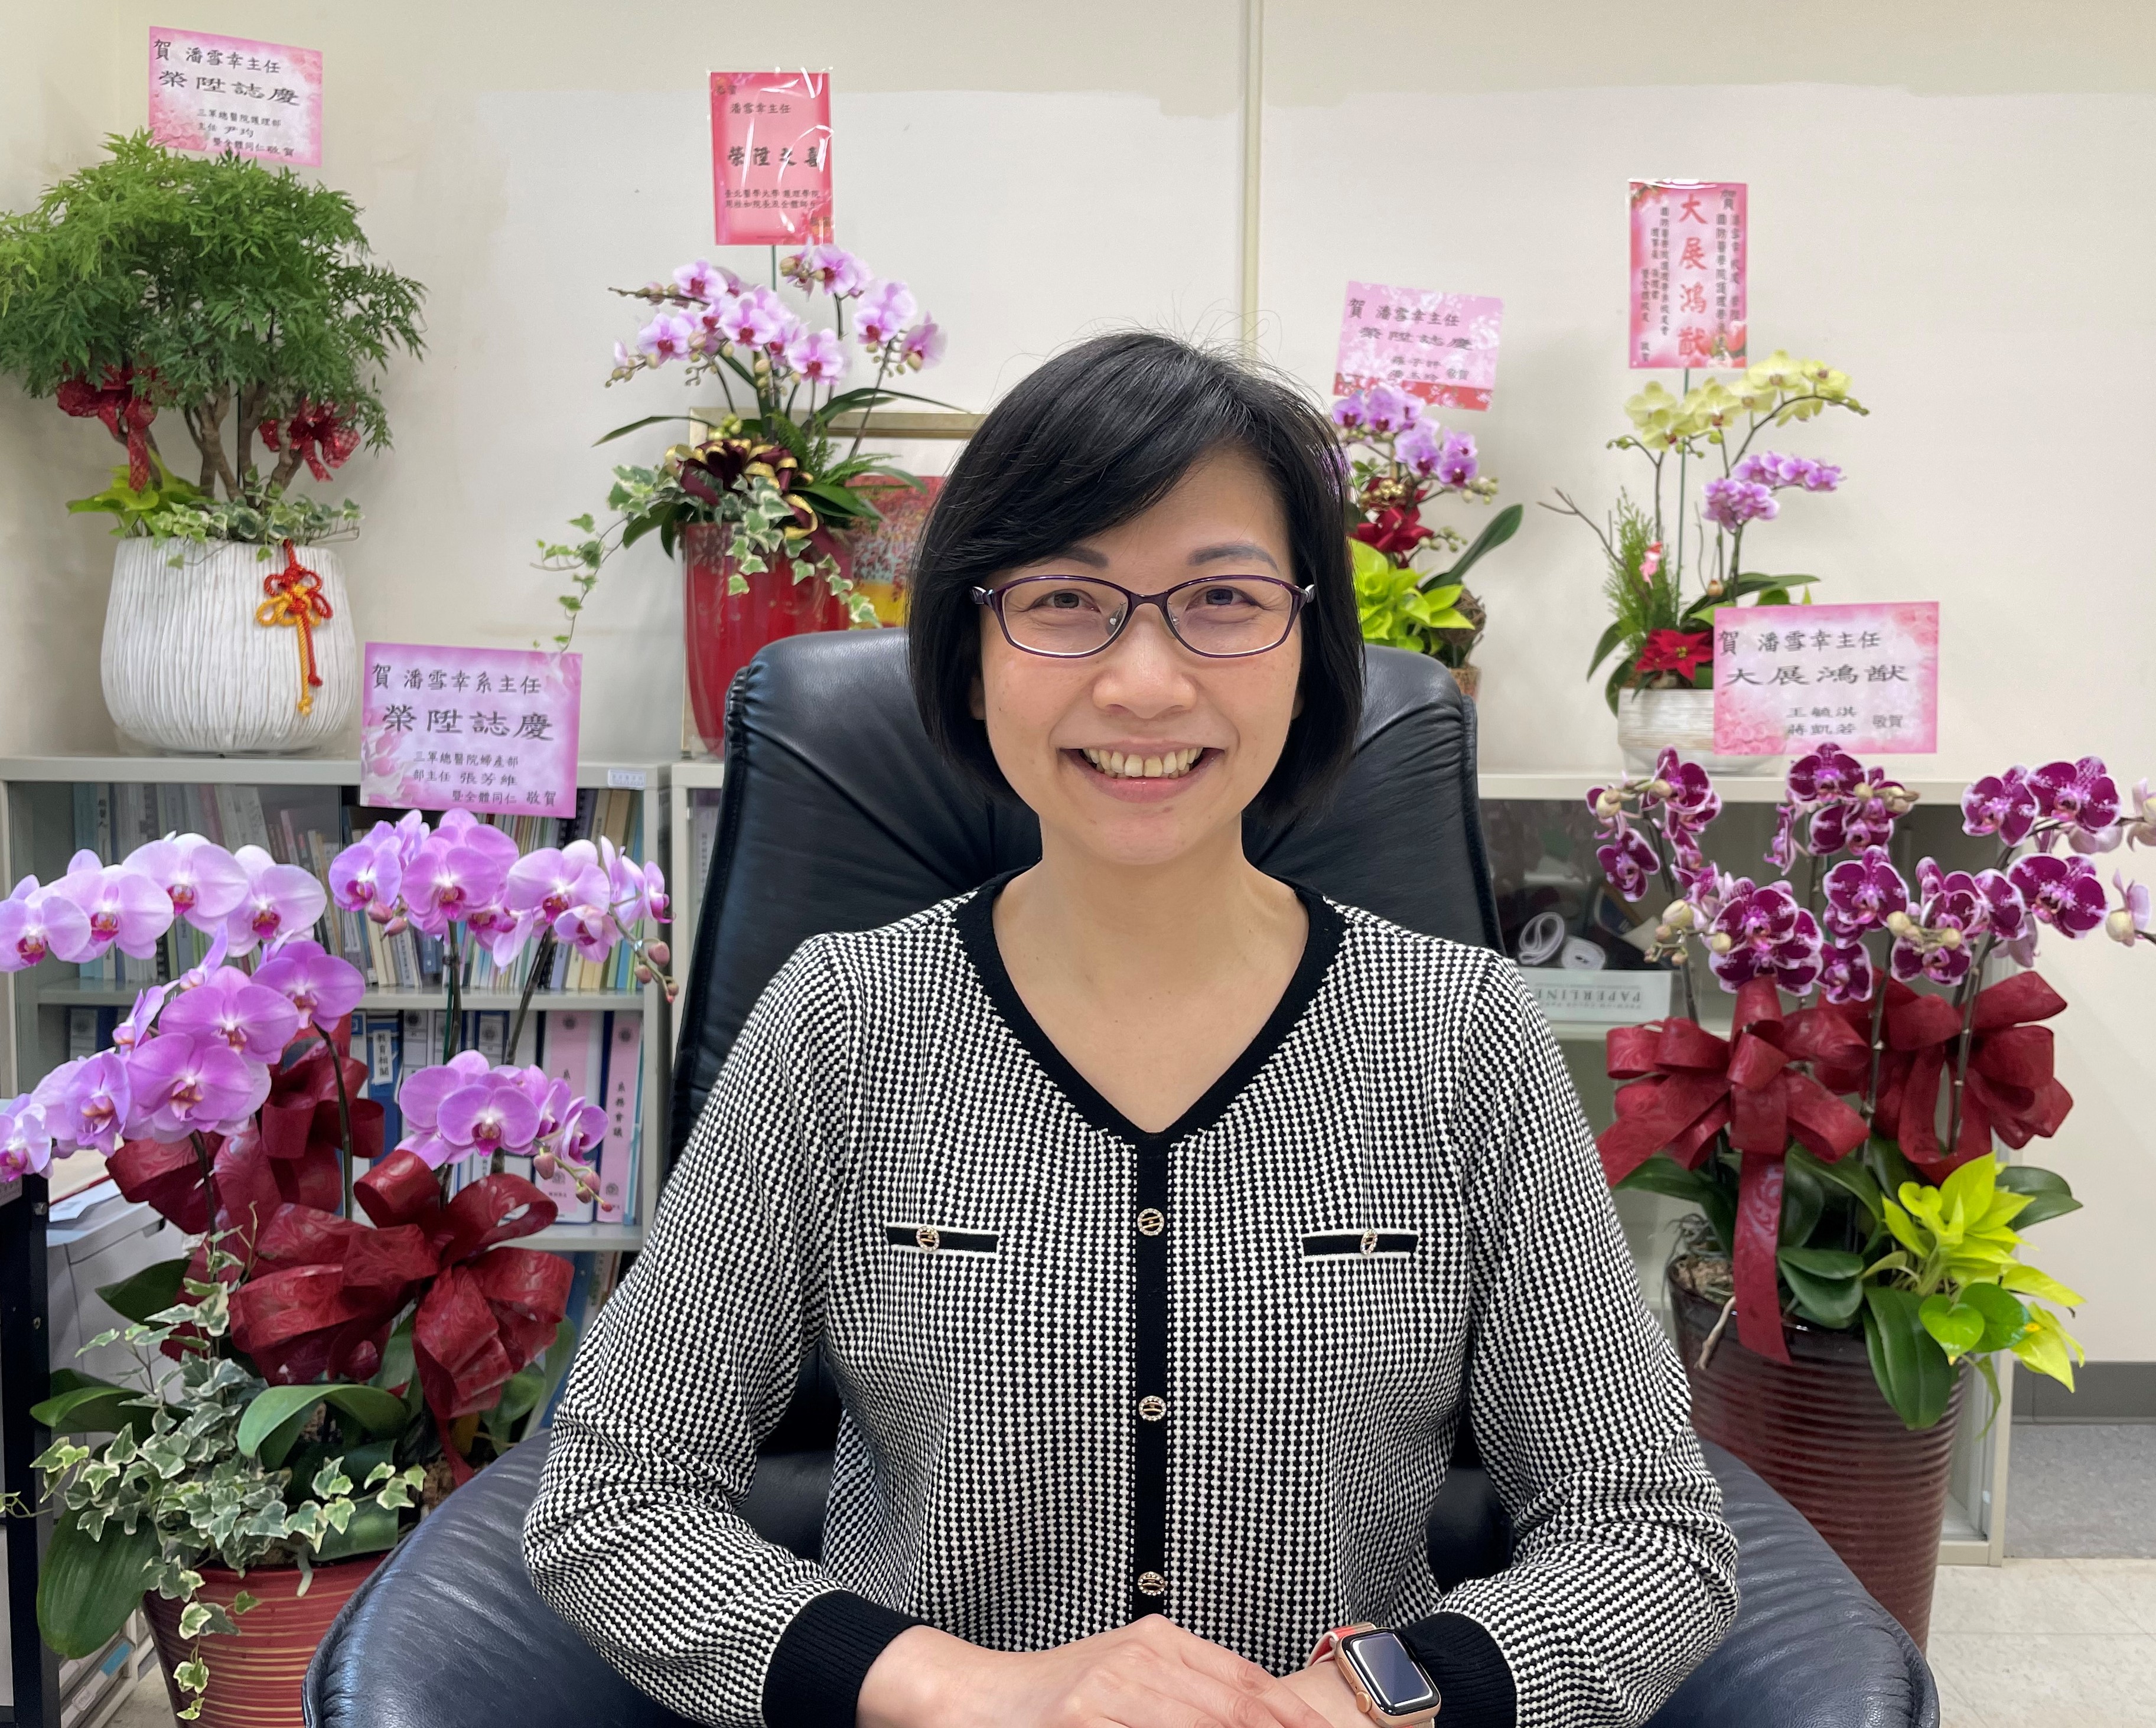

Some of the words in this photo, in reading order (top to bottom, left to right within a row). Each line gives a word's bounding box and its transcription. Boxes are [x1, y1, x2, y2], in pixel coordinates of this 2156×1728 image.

[154, 39, 171, 60] 賀
[185, 47, 281, 73] 潘雪幸主任
[159, 70, 300, 106] 榮陞誌慶
[1678, 193, 1708, 356] 大展鴻猷
[1349, 298, 1366, 319] 賀
[1718, 630, 1739, 656] 賀
[1758, 630, 1881, 652] 潘雪幸主任
[372, 663, 391, 689] 賀
[404, 668, 542, 695] 潘雪幸系主任
[1722, 664, 1909, 686] 大展鴻猷
[382, 703, 554, 741] 榮陞誌慶
[414, 751, 519, 768] 三軍總醫院婦產部
[413, 770, 451, 783] 部主任
